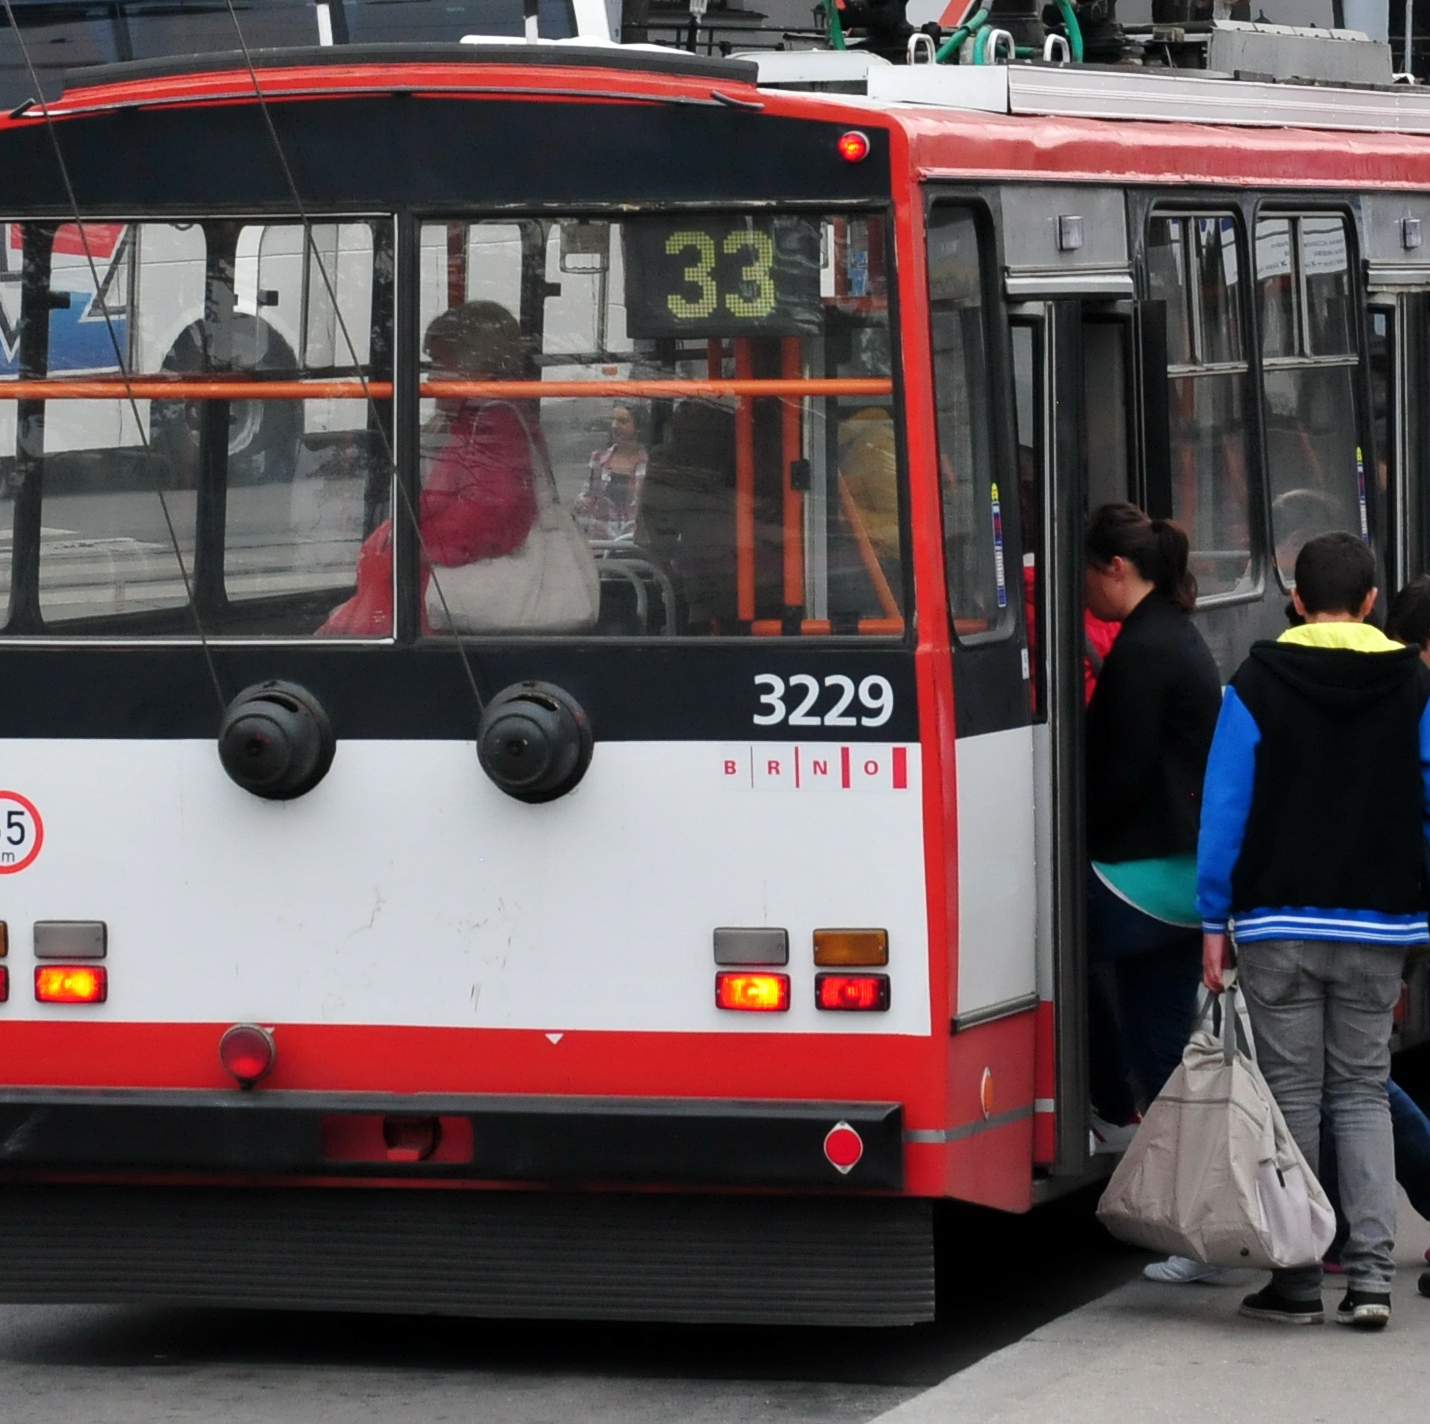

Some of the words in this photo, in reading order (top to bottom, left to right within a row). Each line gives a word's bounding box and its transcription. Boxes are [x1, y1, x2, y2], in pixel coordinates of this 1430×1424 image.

[664, 231, 776, 318] 33
[752, 673, 895, 727] 3229
[723, 759, 880, 777] BRNO
